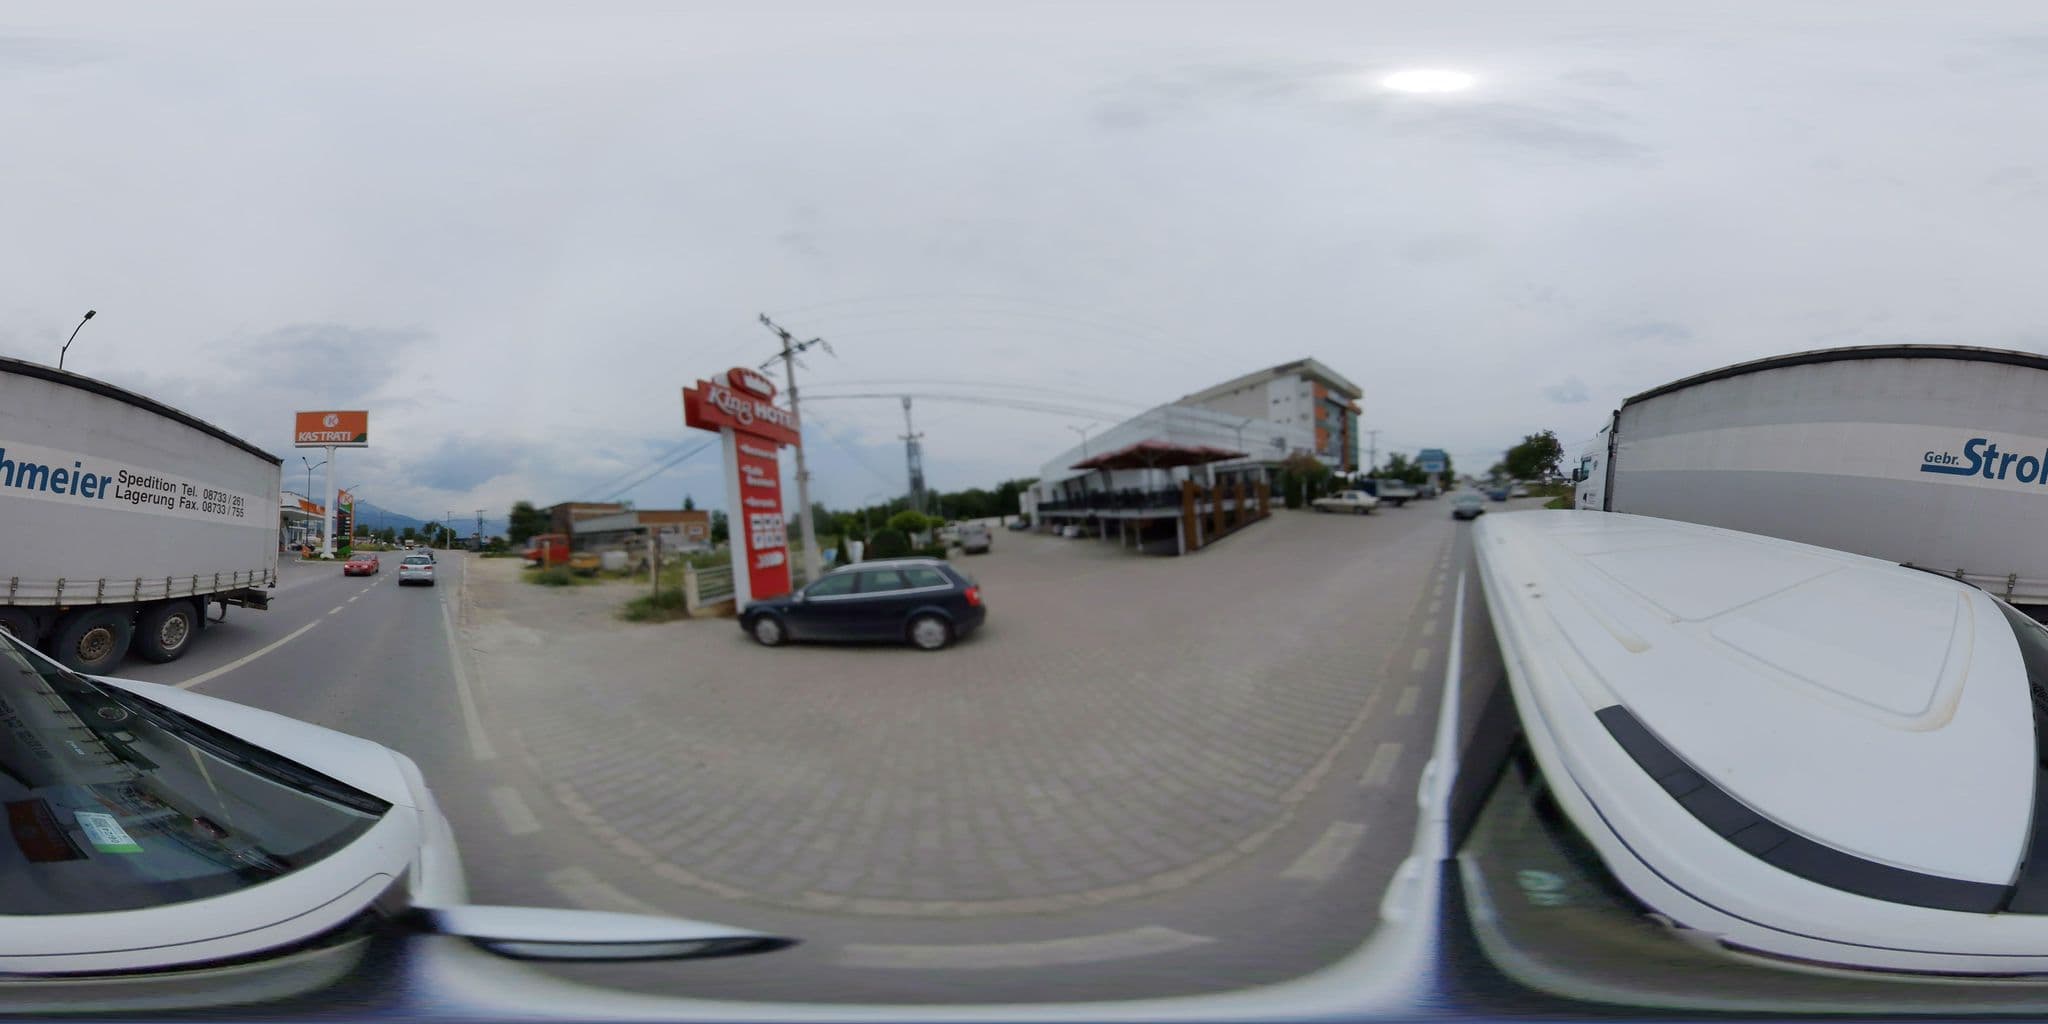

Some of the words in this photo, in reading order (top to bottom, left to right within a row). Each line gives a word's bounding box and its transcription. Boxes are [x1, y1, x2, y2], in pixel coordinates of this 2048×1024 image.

[708, 386, 753, 425] King
[299, 431, 351, 441] KASTRATI
[1924, 451, 1960, 465] Gebr.
[118, 469, 177, 493] Spedition
[181, 483, 198, 498] Tel.
[115, 485, 175, 510] Lagerung
[179, 496, 199, 511] Fax.
